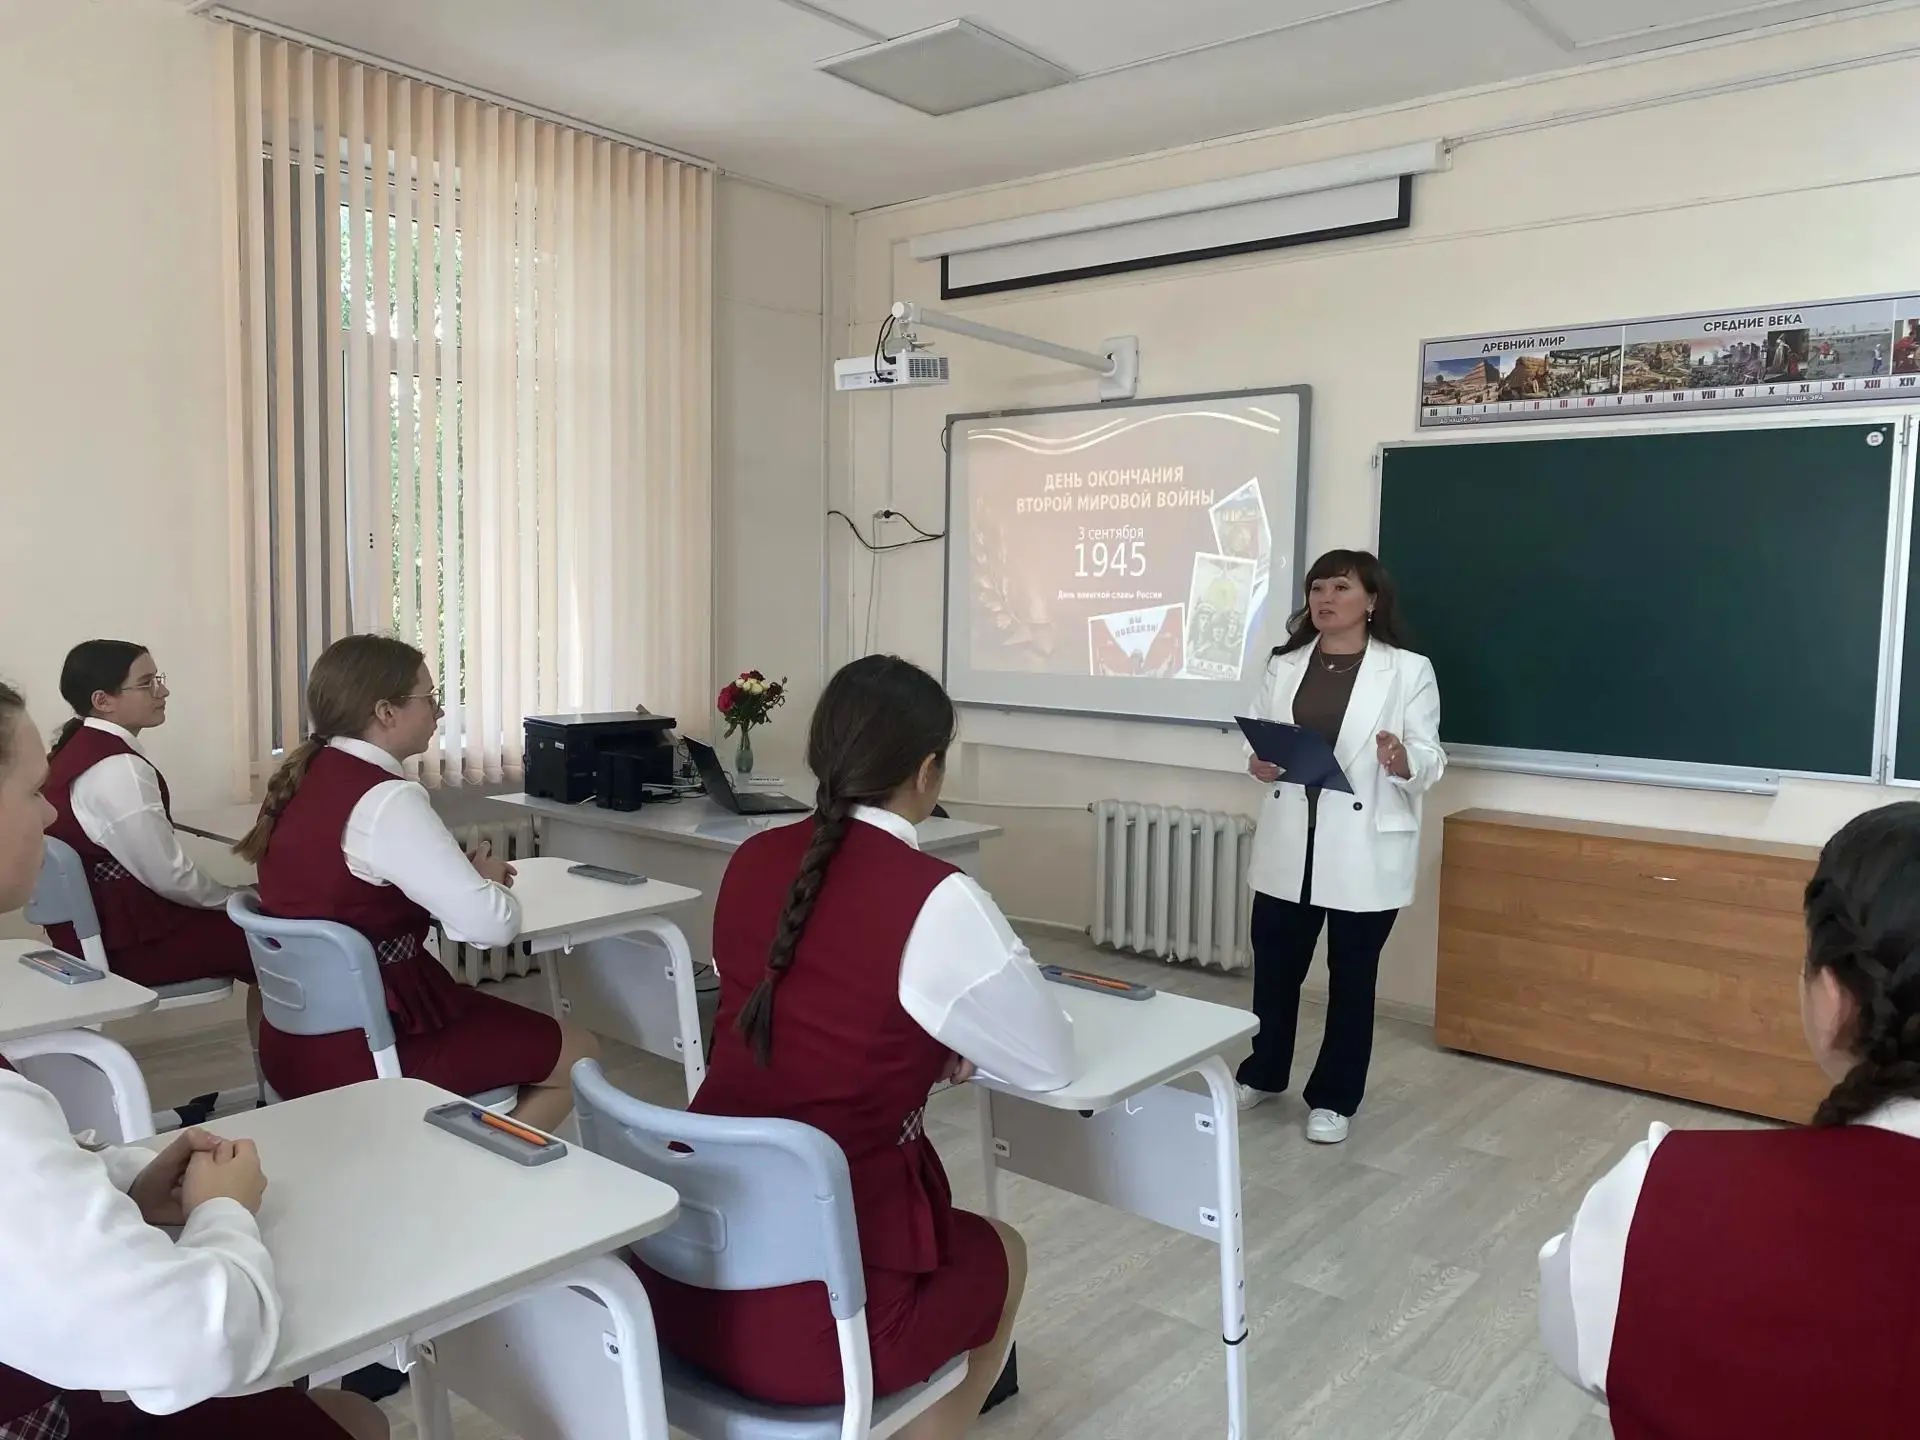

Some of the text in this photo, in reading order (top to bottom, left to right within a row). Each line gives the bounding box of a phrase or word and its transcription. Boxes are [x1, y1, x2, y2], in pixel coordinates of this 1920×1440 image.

[1703, 313, 1803, 332] СРЕДНИЕ ВЕКА
[1482, 336, 1566, 353] ДРЕВНИЙ МИР
[1534, 401, 1540, 410] II
[1559, 399, 1569, 408] III
[1587, 398, 1596, 407] IV
[1617, 396, 1623, 405] V
[1645, 394, 1653, 403] VI
[1672, 392, 1684, 401] VII
[1702, 390, 1716, 400] VIII
[1734, 388, 1744, 398] IX
[1768, 386, 1775, 395] X
[1800, 384, 1810, 393] XI
[1831, 381, 1845, 391] XII
[1863, 379, 1881, 389] XIII
[1899, 377, 1916, 387] XIV
[1044, 466, 1184, 492] ДЕНЬ ОКОНЧАНИЯ
[1016, 487, 1214, 514] ВТОРОЙ МИРОВОЙ ВОЙНЫ
[1078, 524, 1144, 542] 3 сентября
[1074, 541, 1146, 577] 1945
[1136, 589, 1163, 599] России
